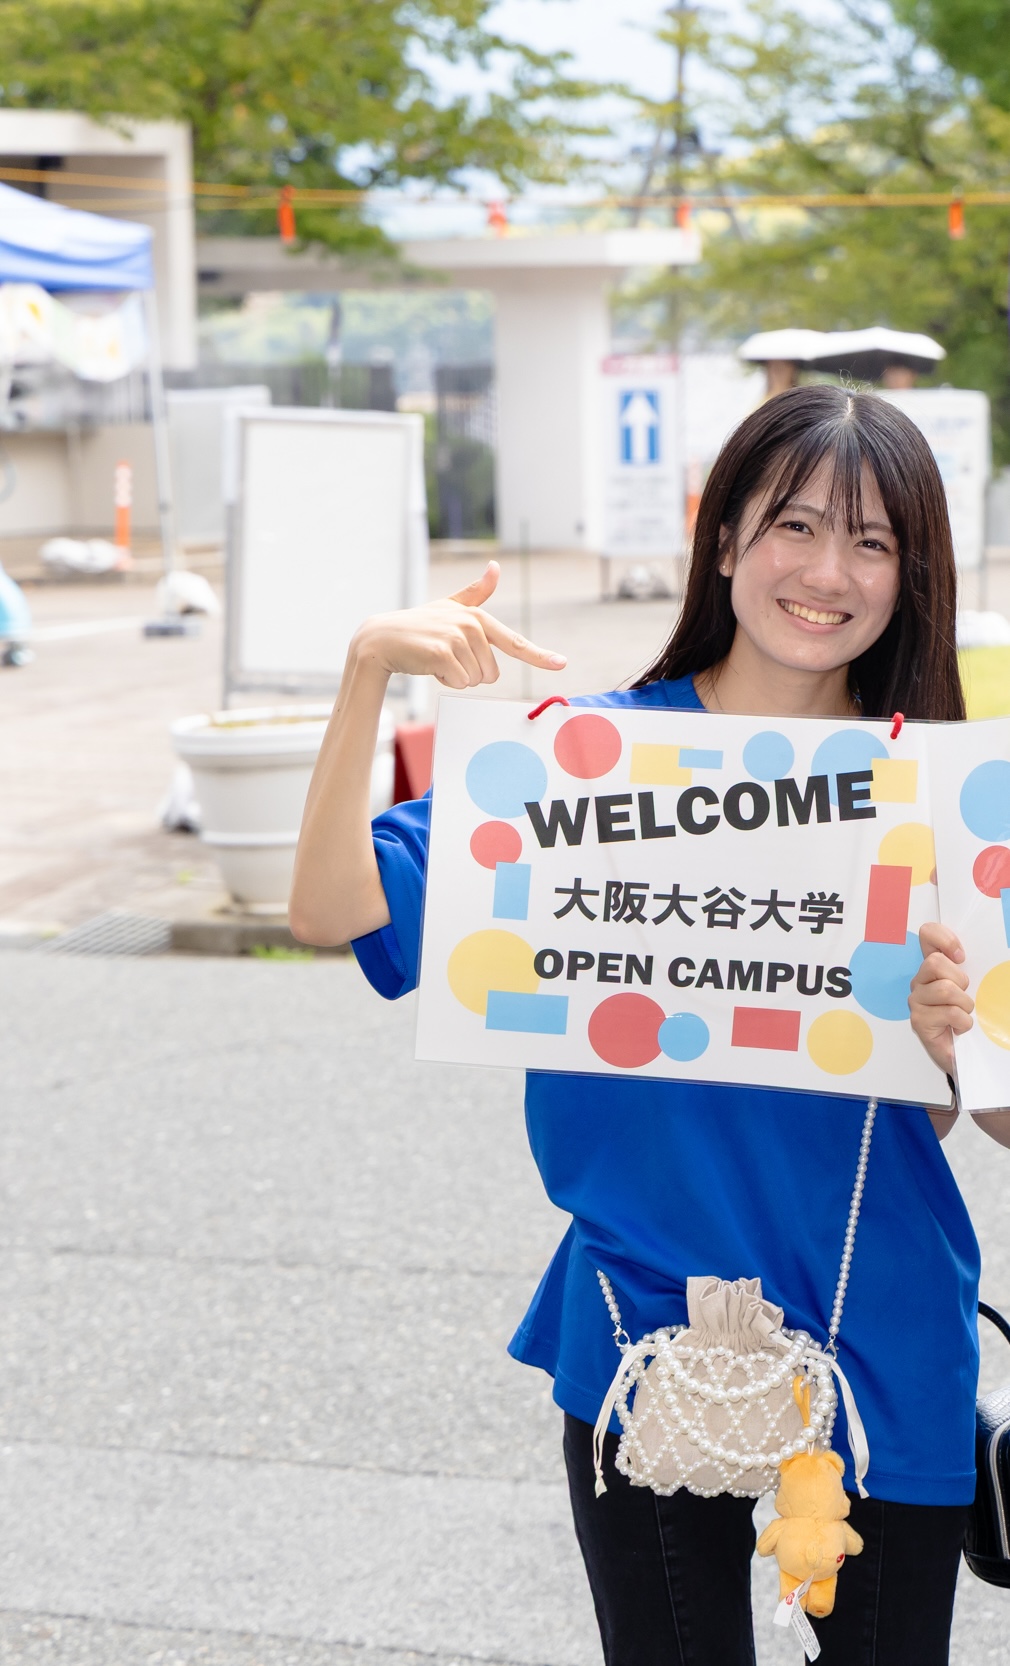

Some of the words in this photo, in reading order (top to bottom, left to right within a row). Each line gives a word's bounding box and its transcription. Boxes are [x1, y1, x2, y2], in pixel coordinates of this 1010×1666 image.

[524, 769, 877, 849] WELCOME
[553, 877, 844, 935] 大阪大谷大学
[533, 948, 654, 985] OPEN
[667, 957, 852, 998] CAMPUS
